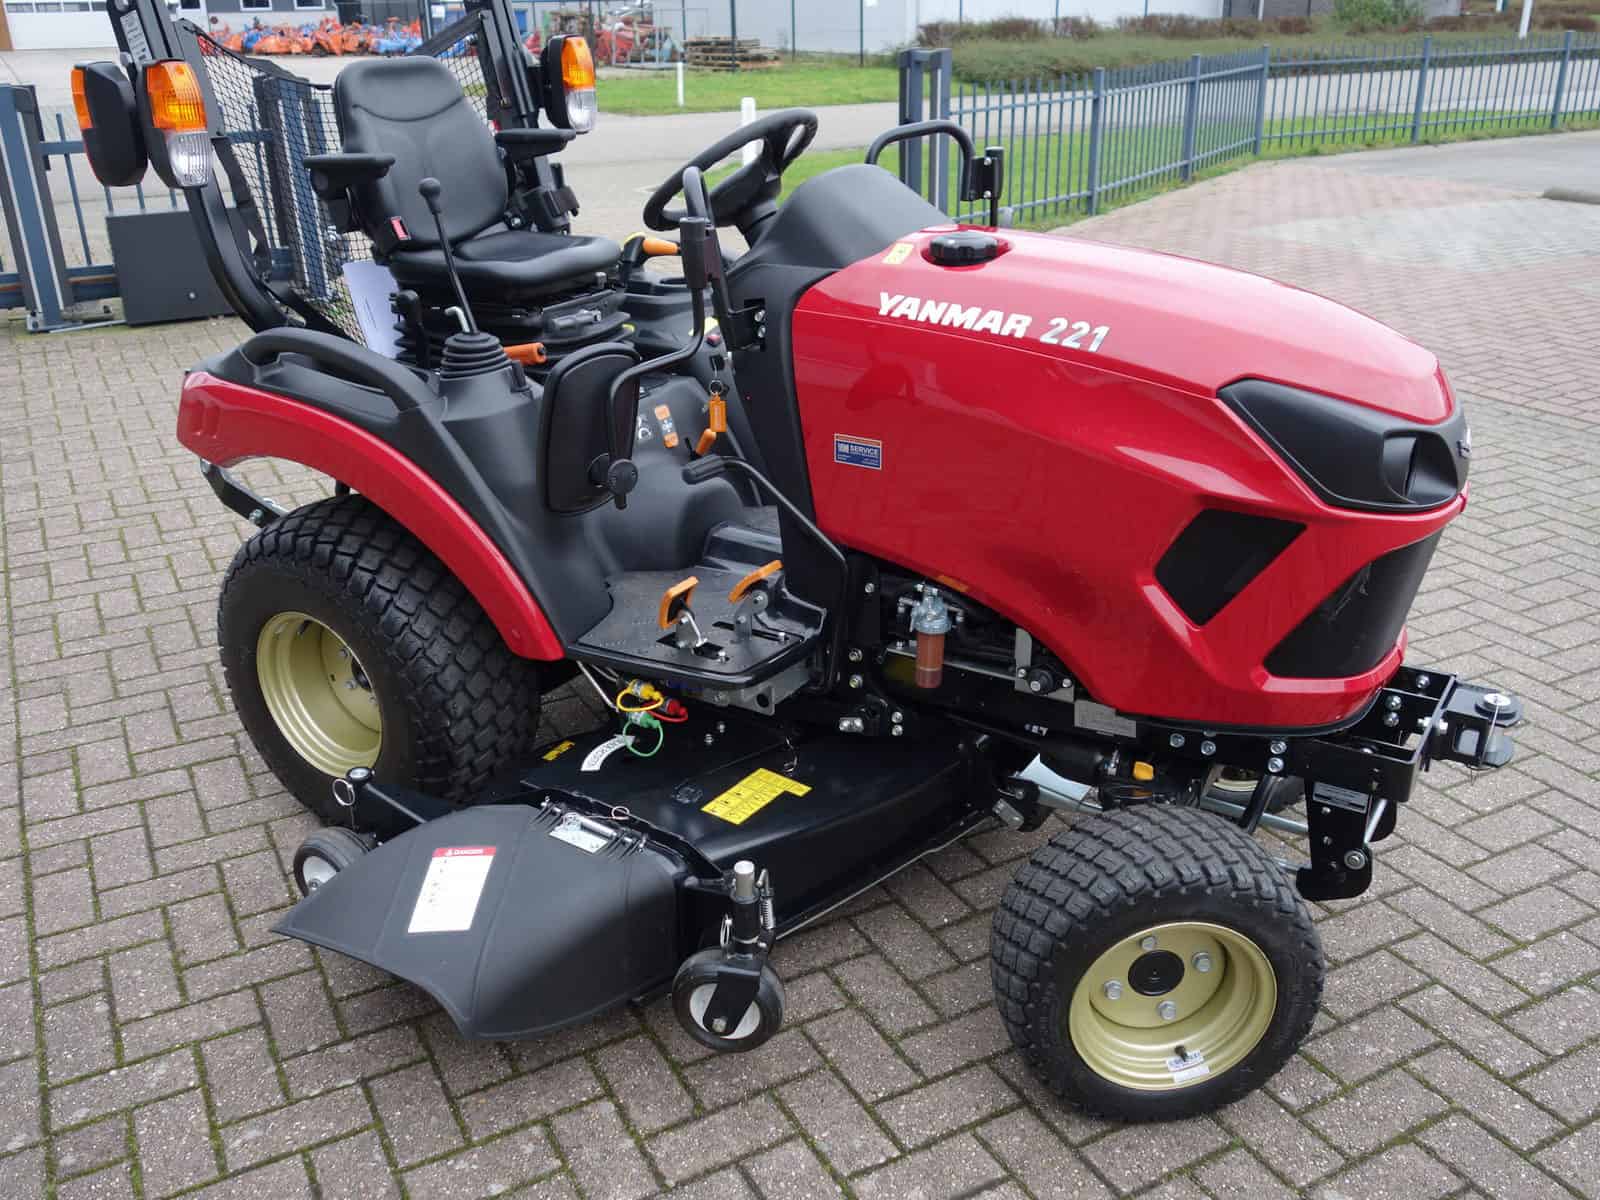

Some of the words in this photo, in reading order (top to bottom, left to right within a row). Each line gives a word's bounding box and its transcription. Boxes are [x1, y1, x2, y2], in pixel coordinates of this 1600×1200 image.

[878, 292, 1032, 338] YANMAR
[1040, 317, 1110, 352] 221
[850, 445, 879, 456] SERVICE
